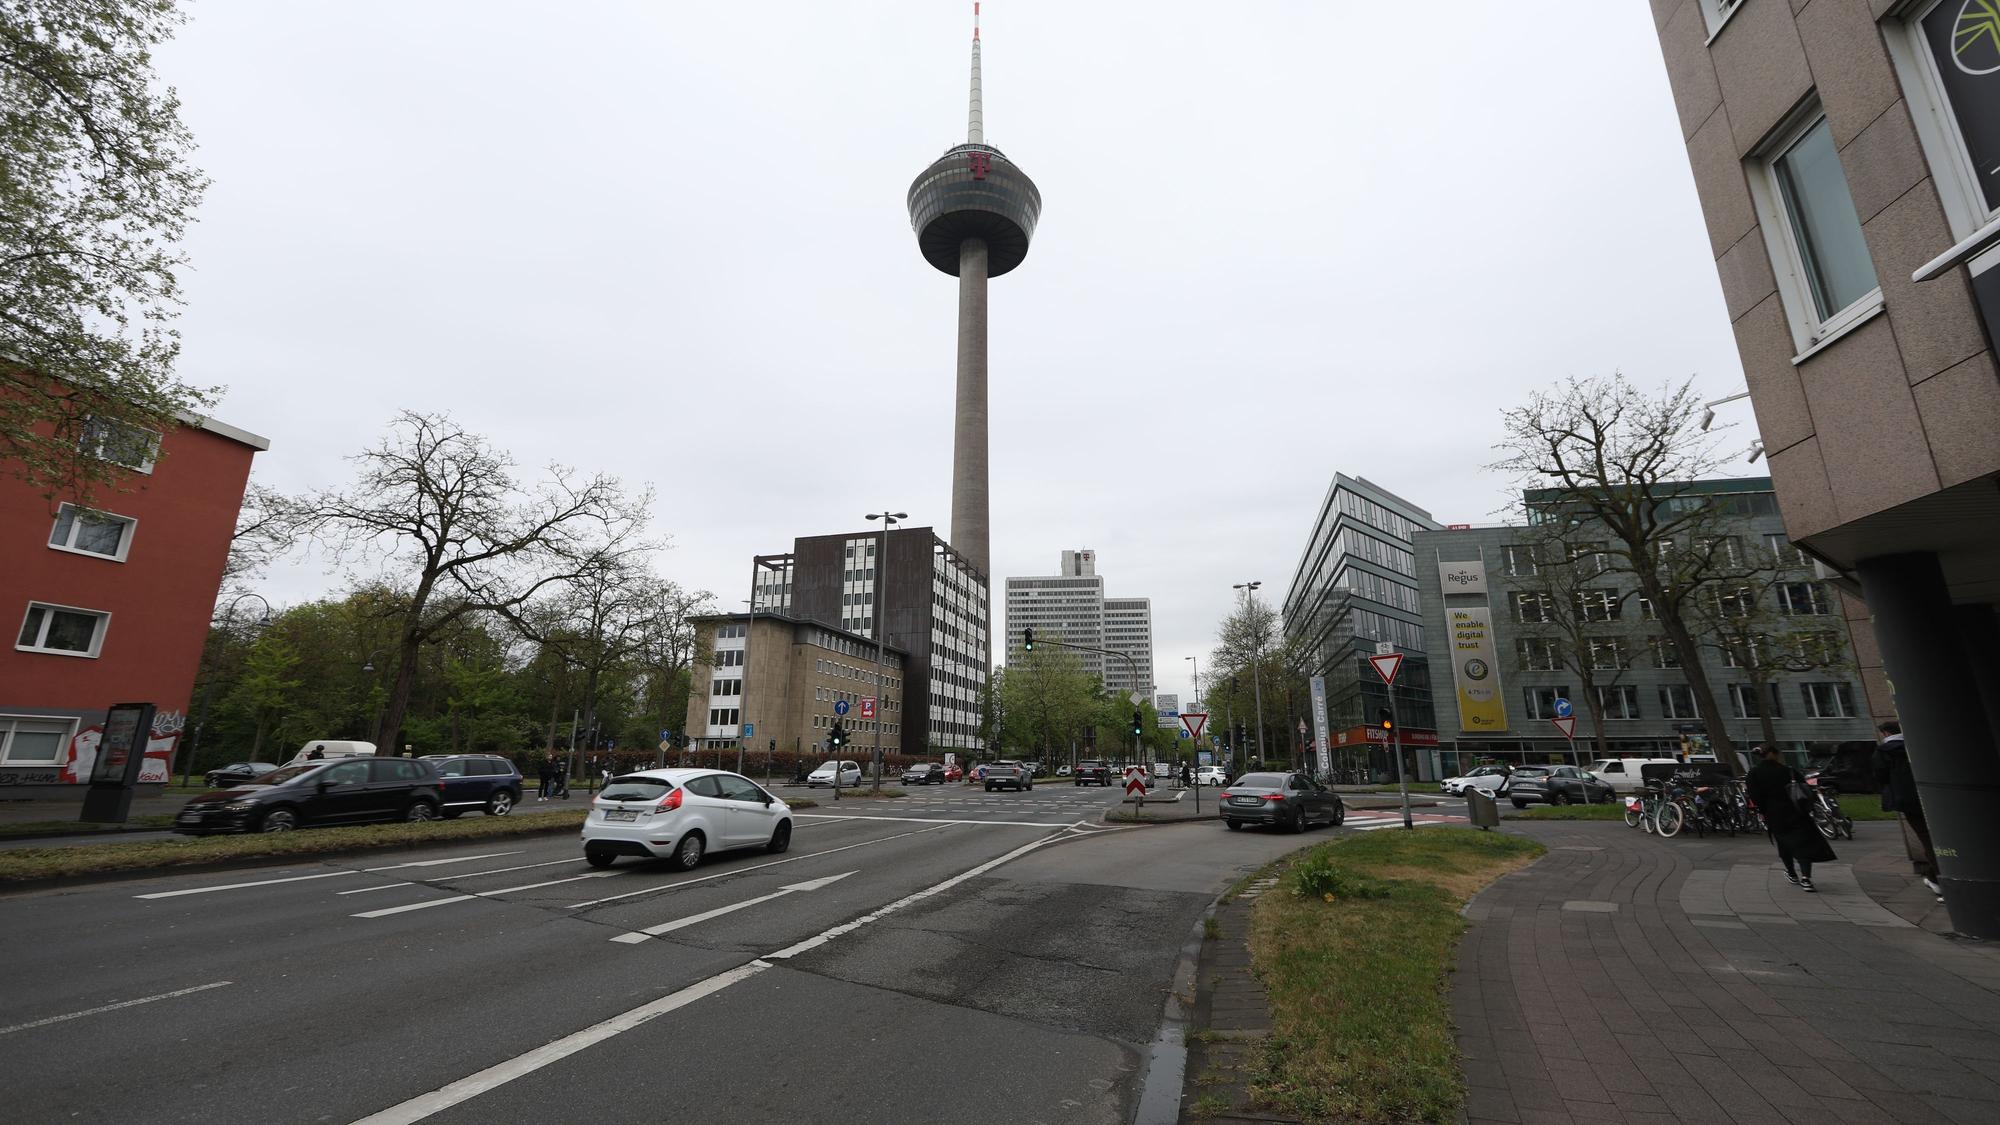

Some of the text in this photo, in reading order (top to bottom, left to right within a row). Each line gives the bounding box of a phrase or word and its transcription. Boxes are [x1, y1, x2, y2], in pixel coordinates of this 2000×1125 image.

[1448, 573, 1478, 585] Regus
[1455, 621, 1484, 629] enable
[1457, 630, 1484, 640] digital
[1315, 696, 1330, 769] Colonius Carré
